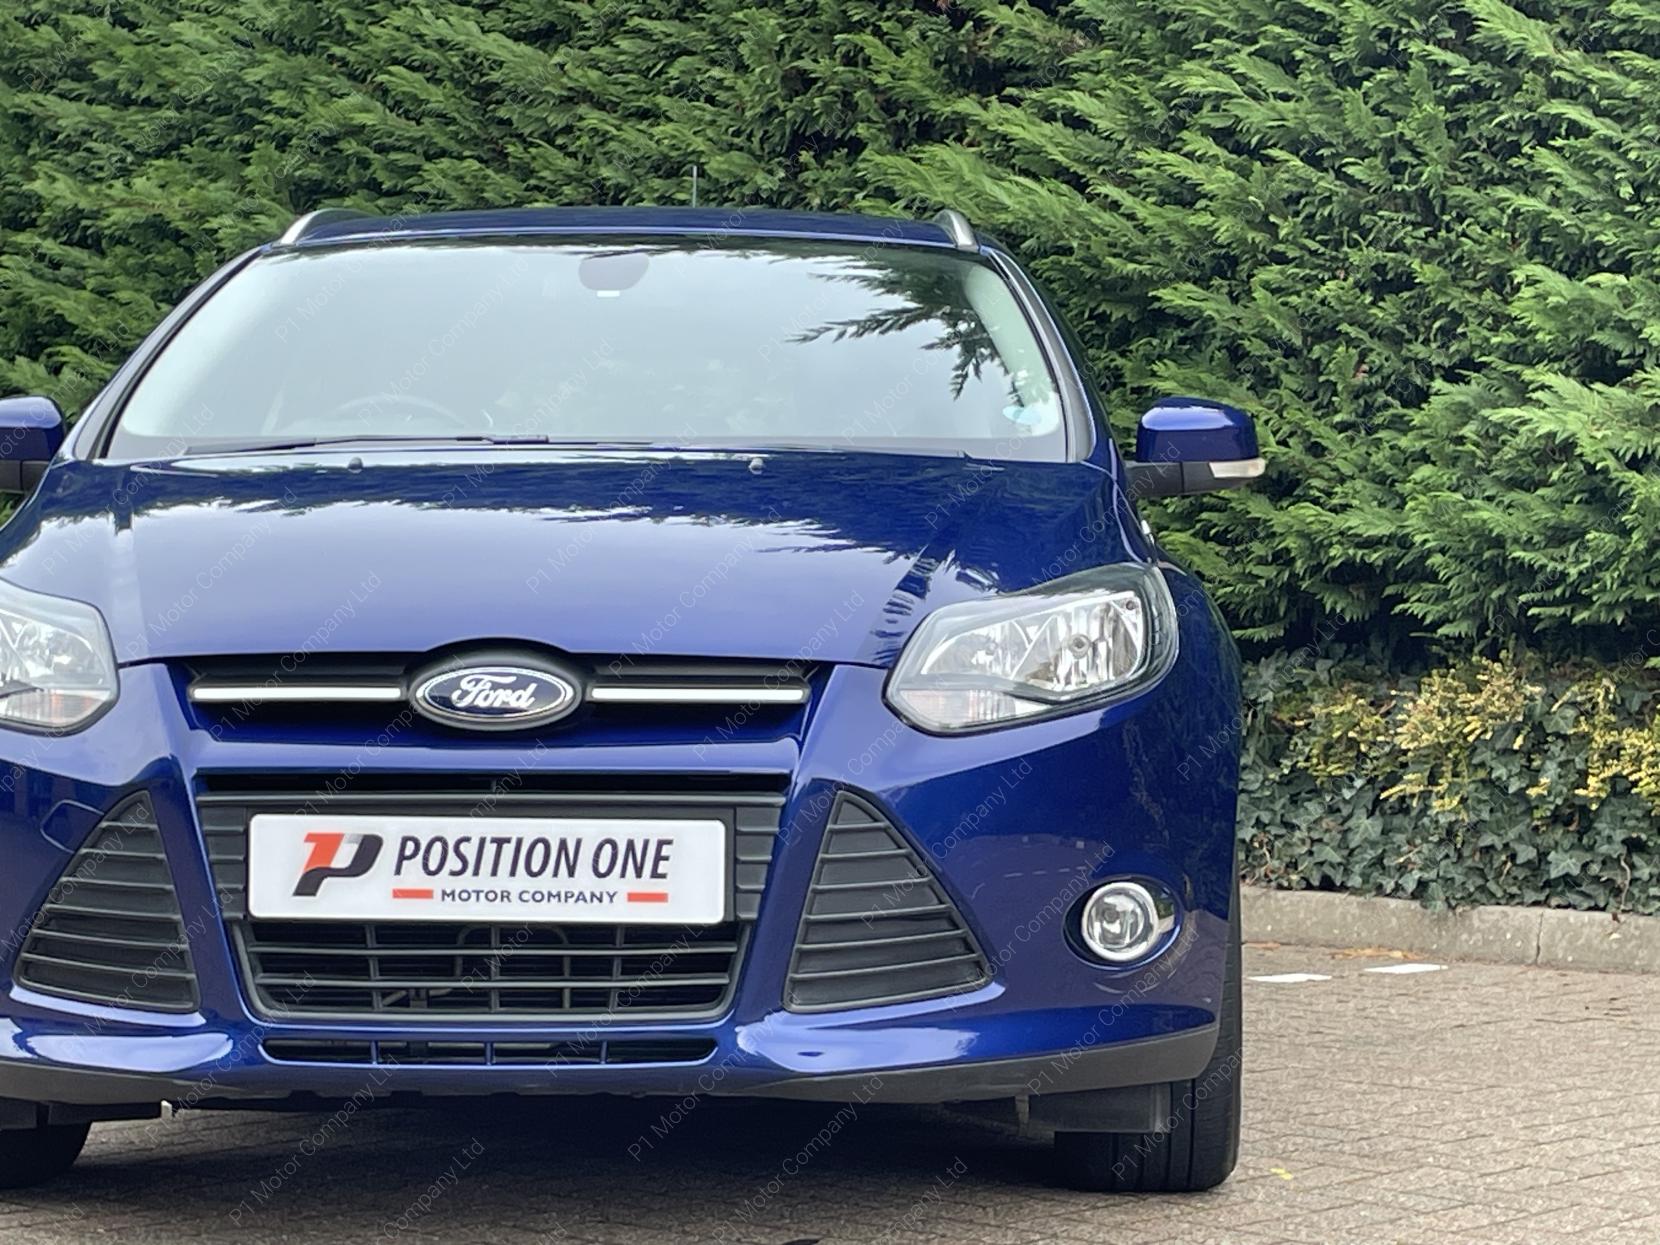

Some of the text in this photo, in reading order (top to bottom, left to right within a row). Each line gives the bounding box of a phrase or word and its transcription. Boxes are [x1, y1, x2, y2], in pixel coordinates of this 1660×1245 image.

[452, 674, 538, 708] Ford
[394, 835, 674, 880] POSITION ONE
[441, 889, 618, 904] MOTOR COMPANY
